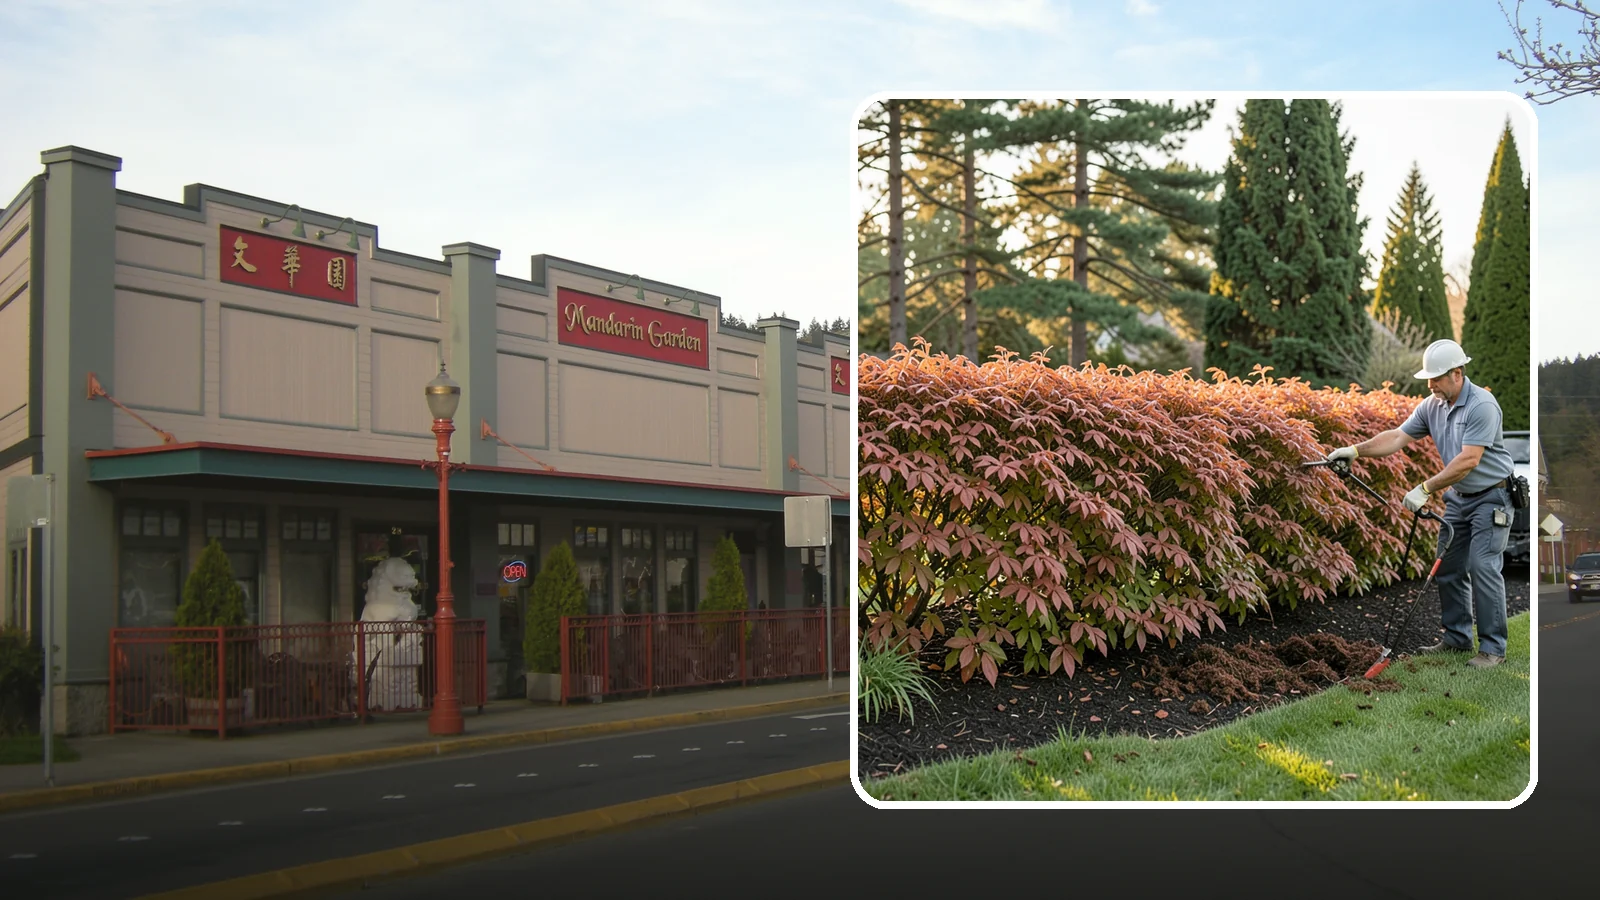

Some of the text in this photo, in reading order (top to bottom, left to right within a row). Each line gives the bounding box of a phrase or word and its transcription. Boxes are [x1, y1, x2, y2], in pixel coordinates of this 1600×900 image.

[564, 302, 702, 352] Mandarin Garden
[503, 565, 527, 578] OPEN
